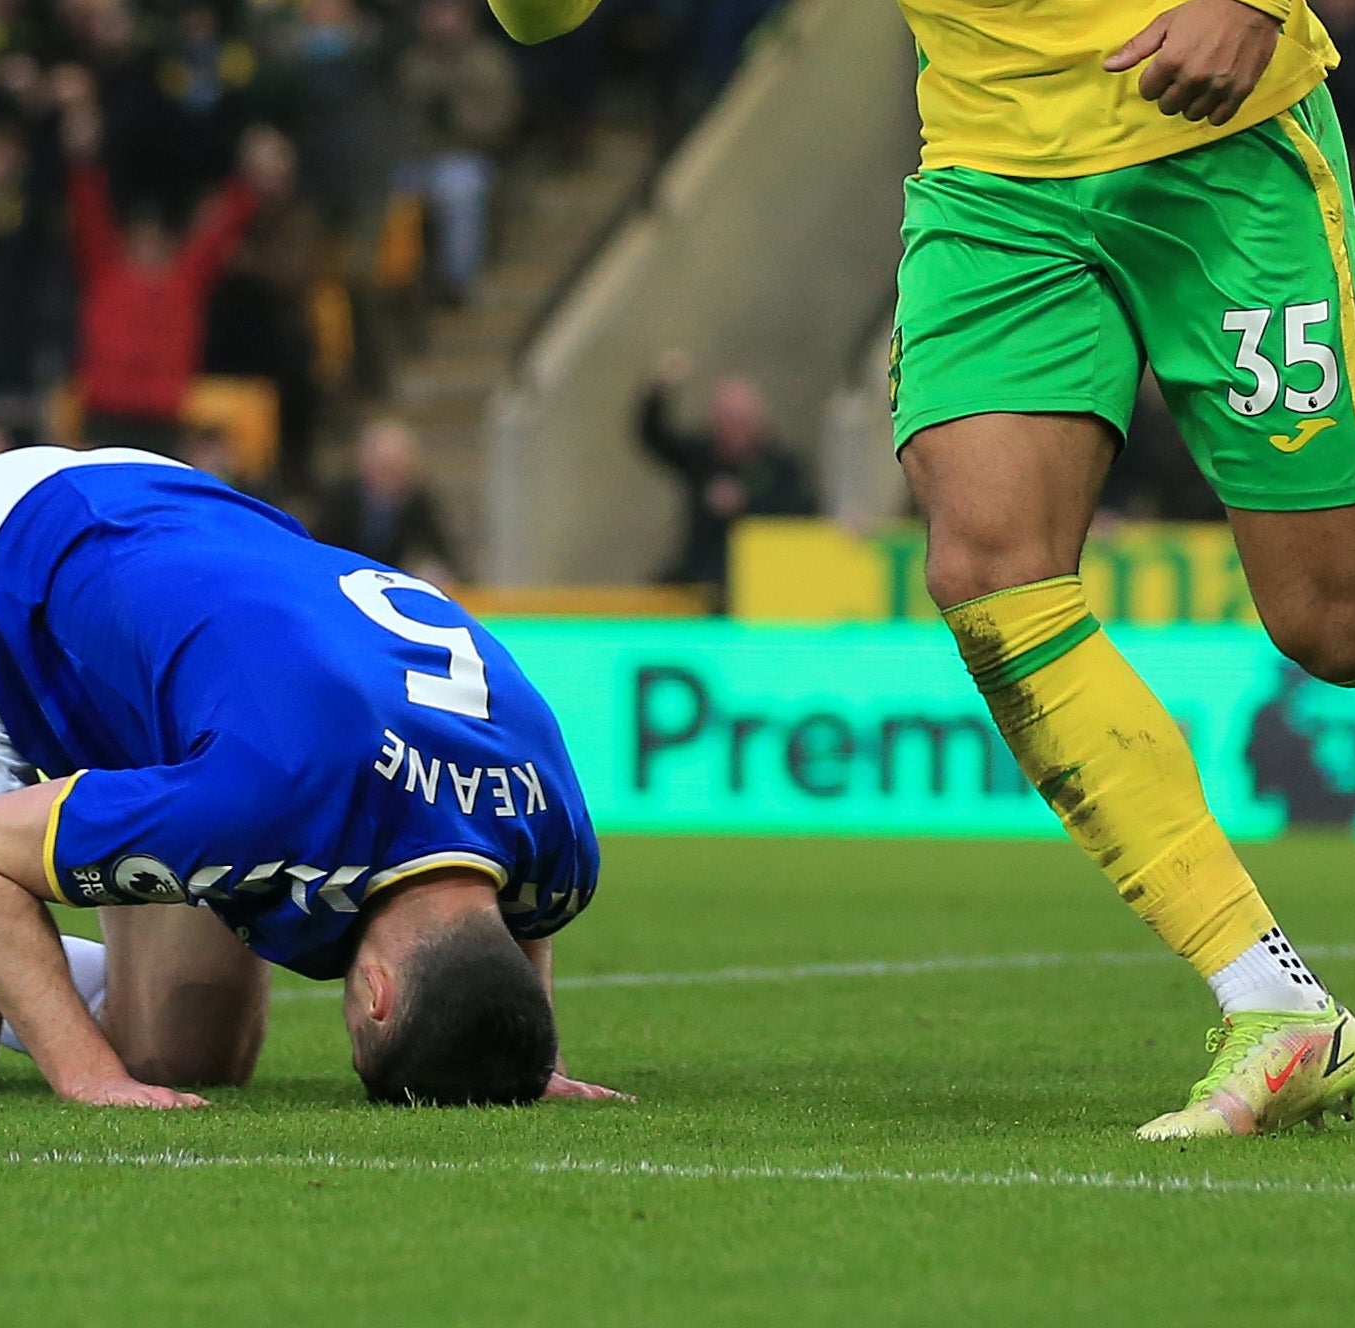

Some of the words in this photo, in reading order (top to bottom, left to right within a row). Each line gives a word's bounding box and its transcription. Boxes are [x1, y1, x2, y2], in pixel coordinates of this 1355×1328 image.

[1221, 299, 1341, 417] 35
[338, 568, 491, 719] 5
[373, 728, 548, 818] KEANE
